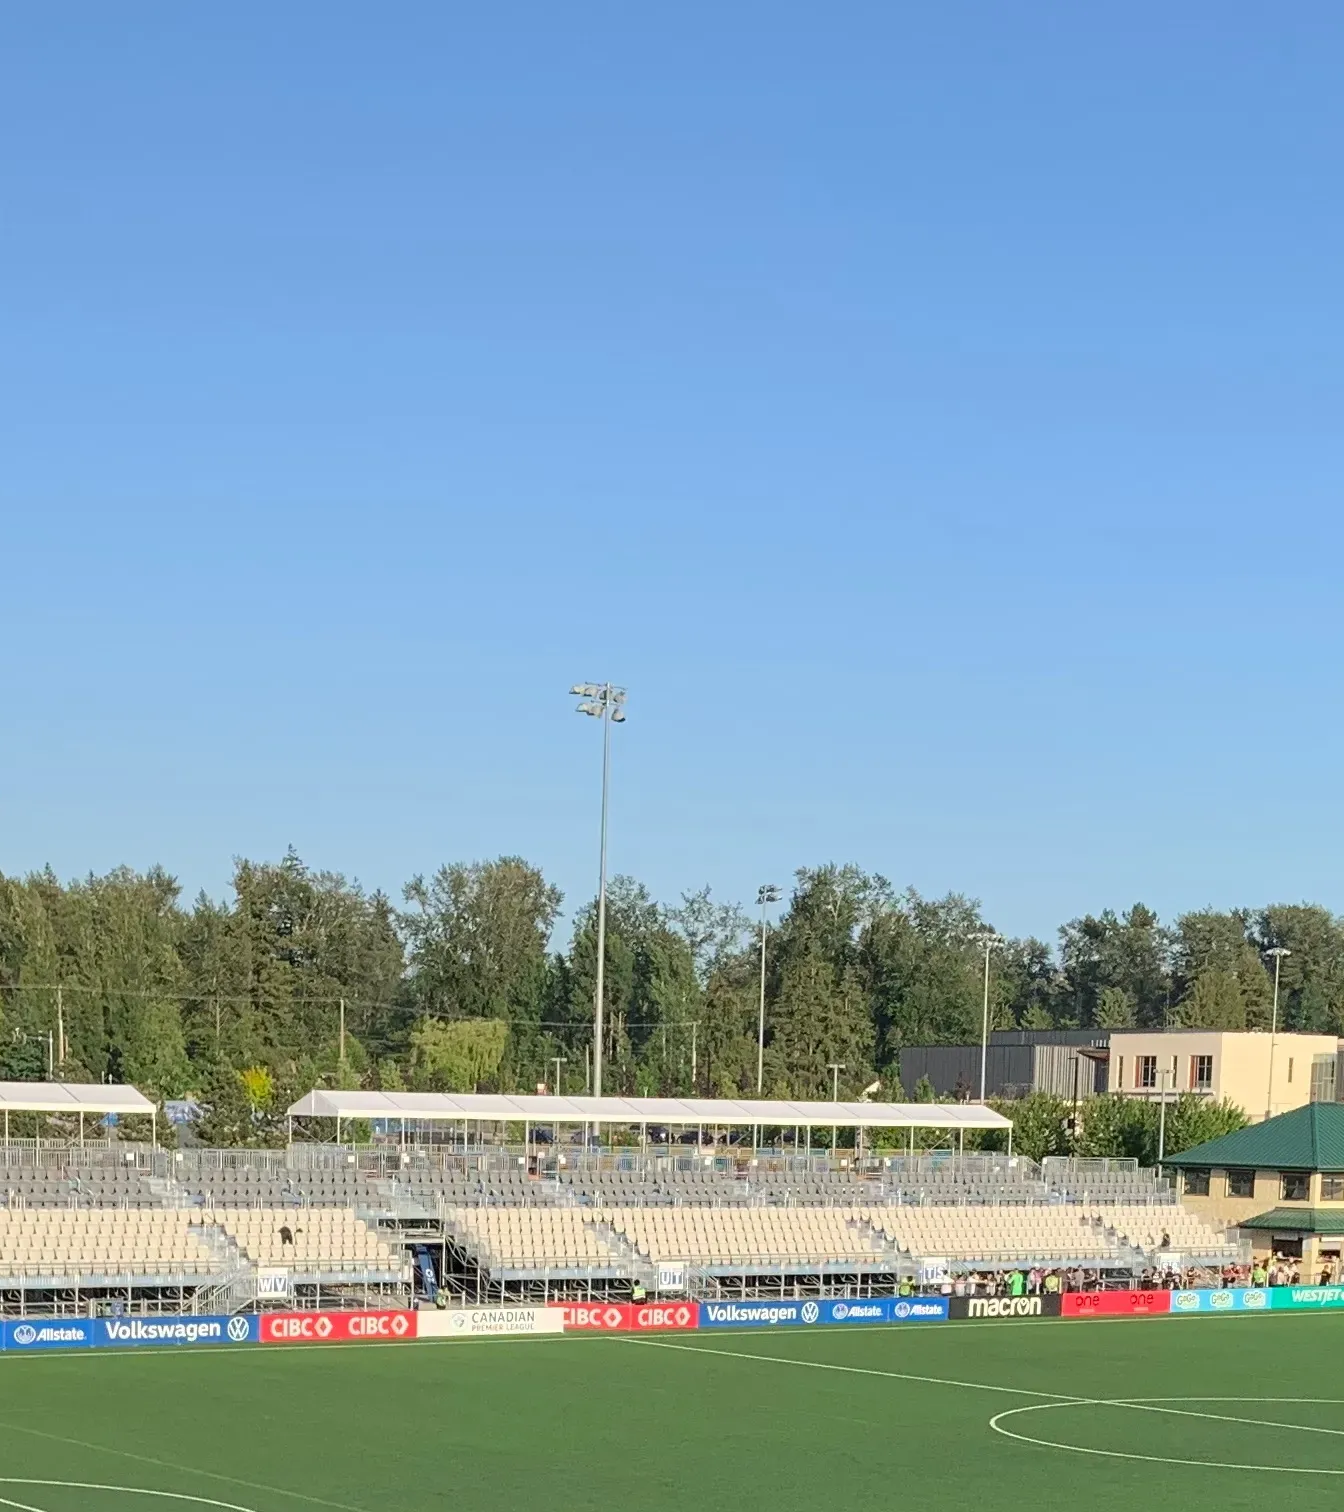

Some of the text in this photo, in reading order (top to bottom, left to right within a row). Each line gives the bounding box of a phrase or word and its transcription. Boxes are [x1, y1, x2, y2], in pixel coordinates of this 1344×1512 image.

[1076, 1295, 1100, 1306] one
[1130, 1294, 1154, 1305] one
[1292, 1289, 1341, 1306] WESTJET
[707, 1304, 796, 1323] Volkswagen
[848, 1305, 882, 1317] Allstate
[910, 1304, 943, 1316] Allstate
[968, 1296, 1041, 1317] macron
[471, 1311, 535, 1324] CANADIAN
[638, 1308, 675, 1326] CIBC
[106, 1320, 221, 1342] Volkswagen
[271, 1318, 313, 1338] CIBC
[348, 1316, 390, 1336] CIBC
[471, 1323, 535, 1332] PREMIER LEAGUE
[36, 1327, 85, 1341] Allstate
